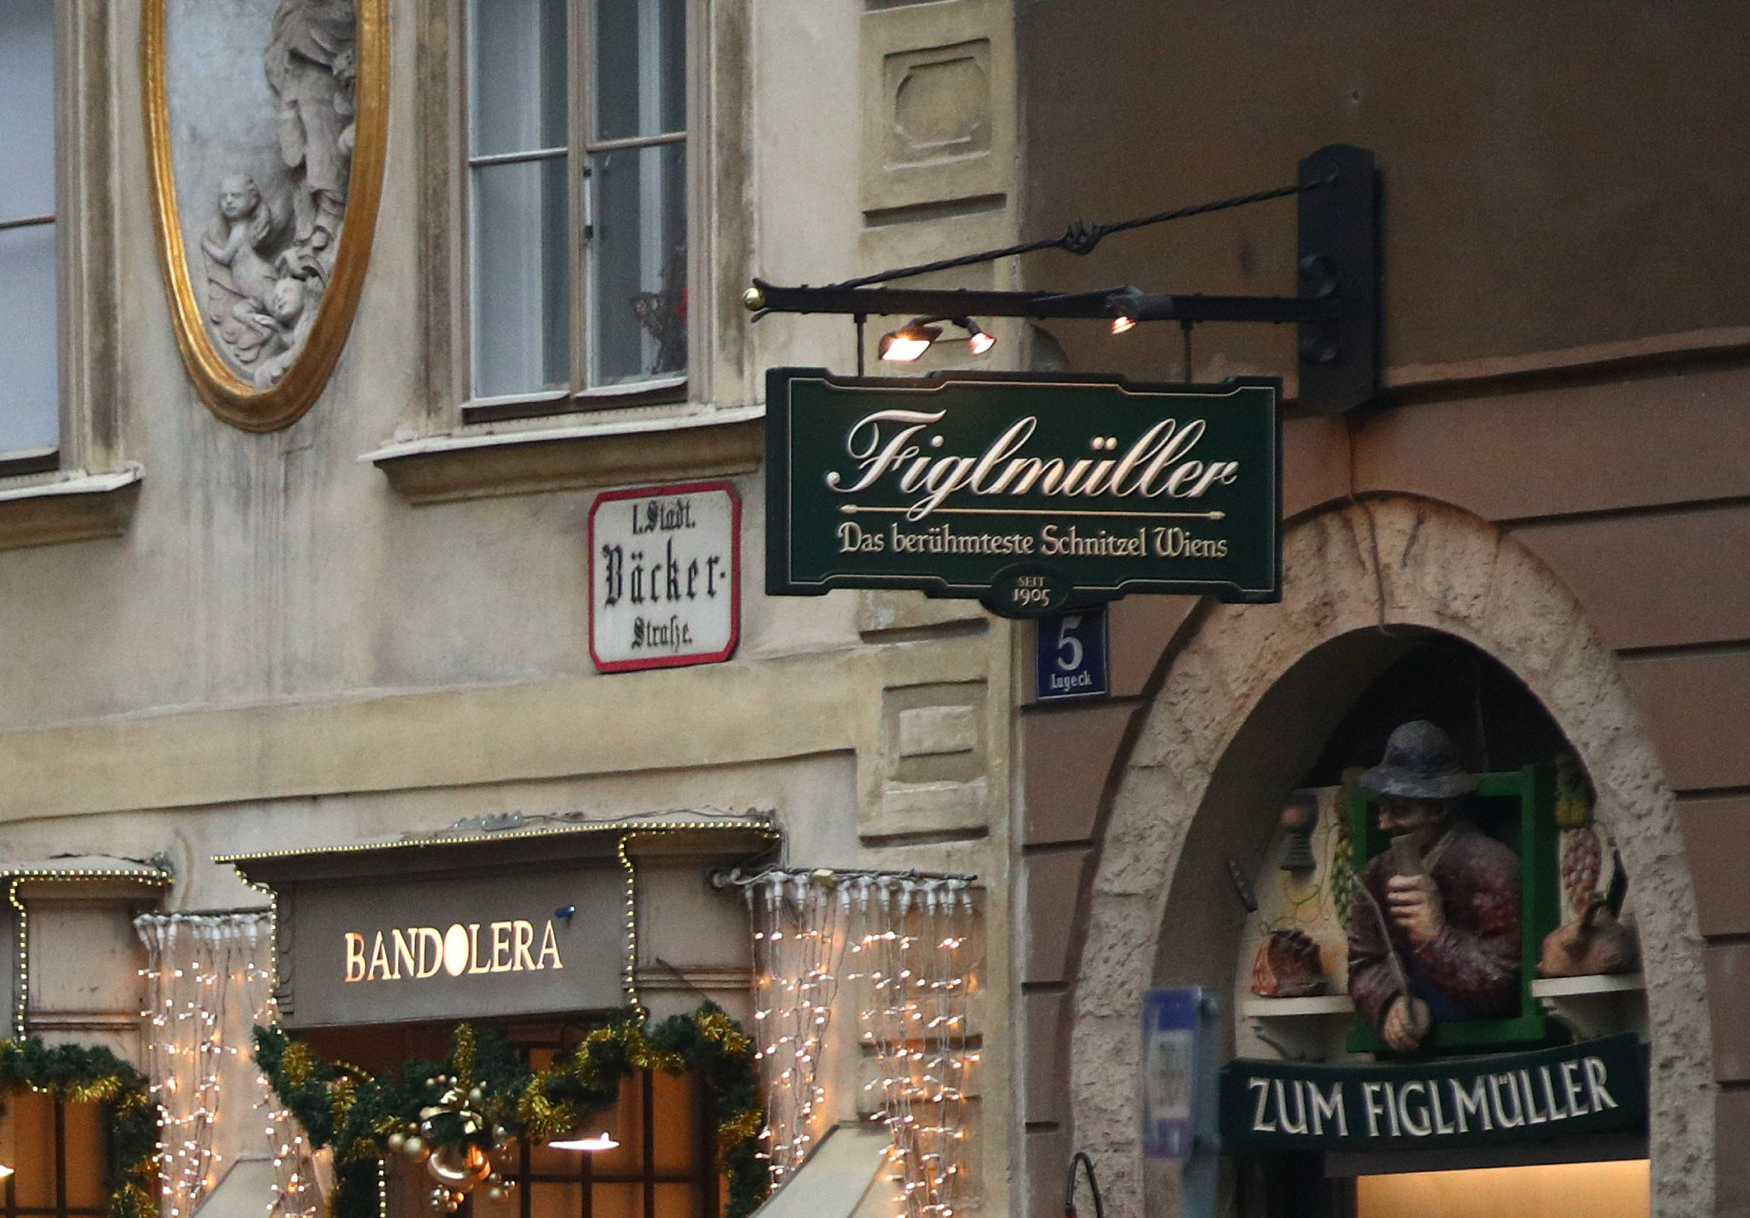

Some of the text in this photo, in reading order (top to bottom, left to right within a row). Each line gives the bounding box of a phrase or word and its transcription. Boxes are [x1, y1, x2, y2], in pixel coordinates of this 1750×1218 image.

[826, 408, 1238, 521] Figlmüller
[837, 522, 1228, 558] Das berühmteste Schnitzel Wiens
[1013, 588, 1051, 607] 1905
[1018, 576, 1046, 588] SEIT
[1057, 614, 1084, 671] 5
[345, 919, 564, 983] BANDOLERA
[1248, 1055, 1618, 1139] ZUM FIGLMÜLLER
